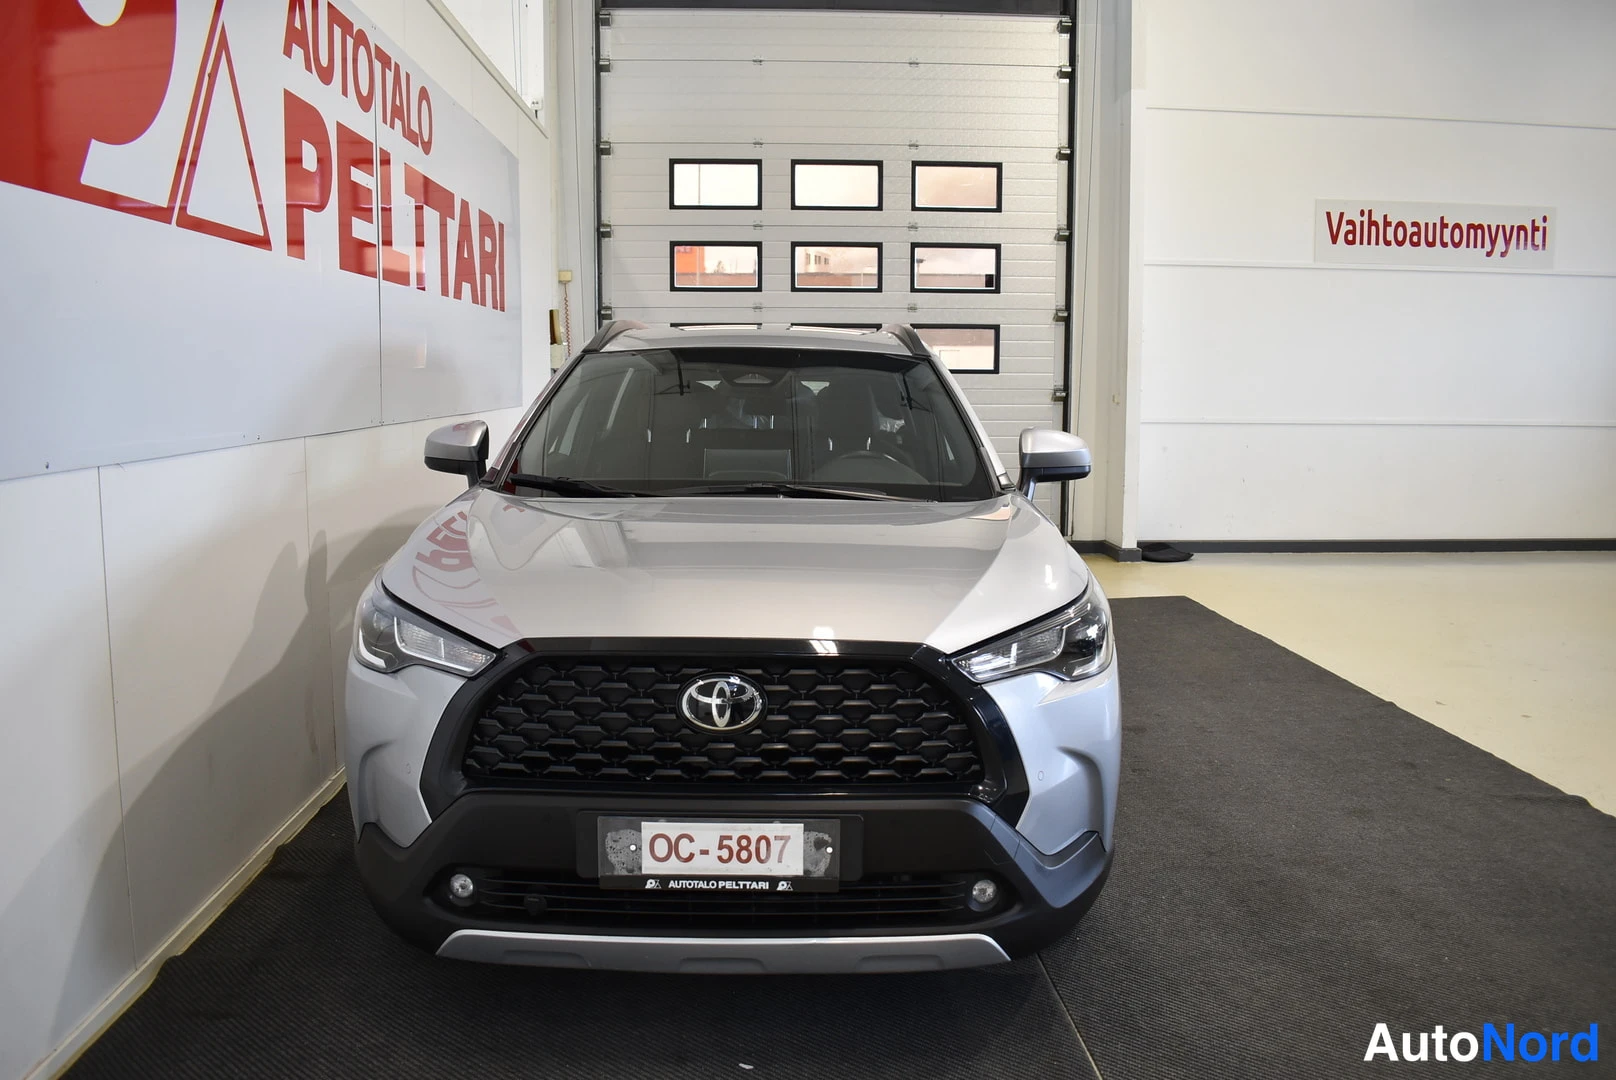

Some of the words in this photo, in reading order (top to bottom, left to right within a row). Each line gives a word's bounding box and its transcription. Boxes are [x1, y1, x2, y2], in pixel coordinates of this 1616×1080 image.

[283, 0, 433, 156] AUTOTALO
[283, 87, 506, 313] PELTTARI
[1325, 208, 1548, 258] Vaihtoautomyynti
[649, 833, 791, 864] OC-5807
[668, 880, 717, 889] AUTOTALO
[718, 880, 769, 890] PELTTARI
